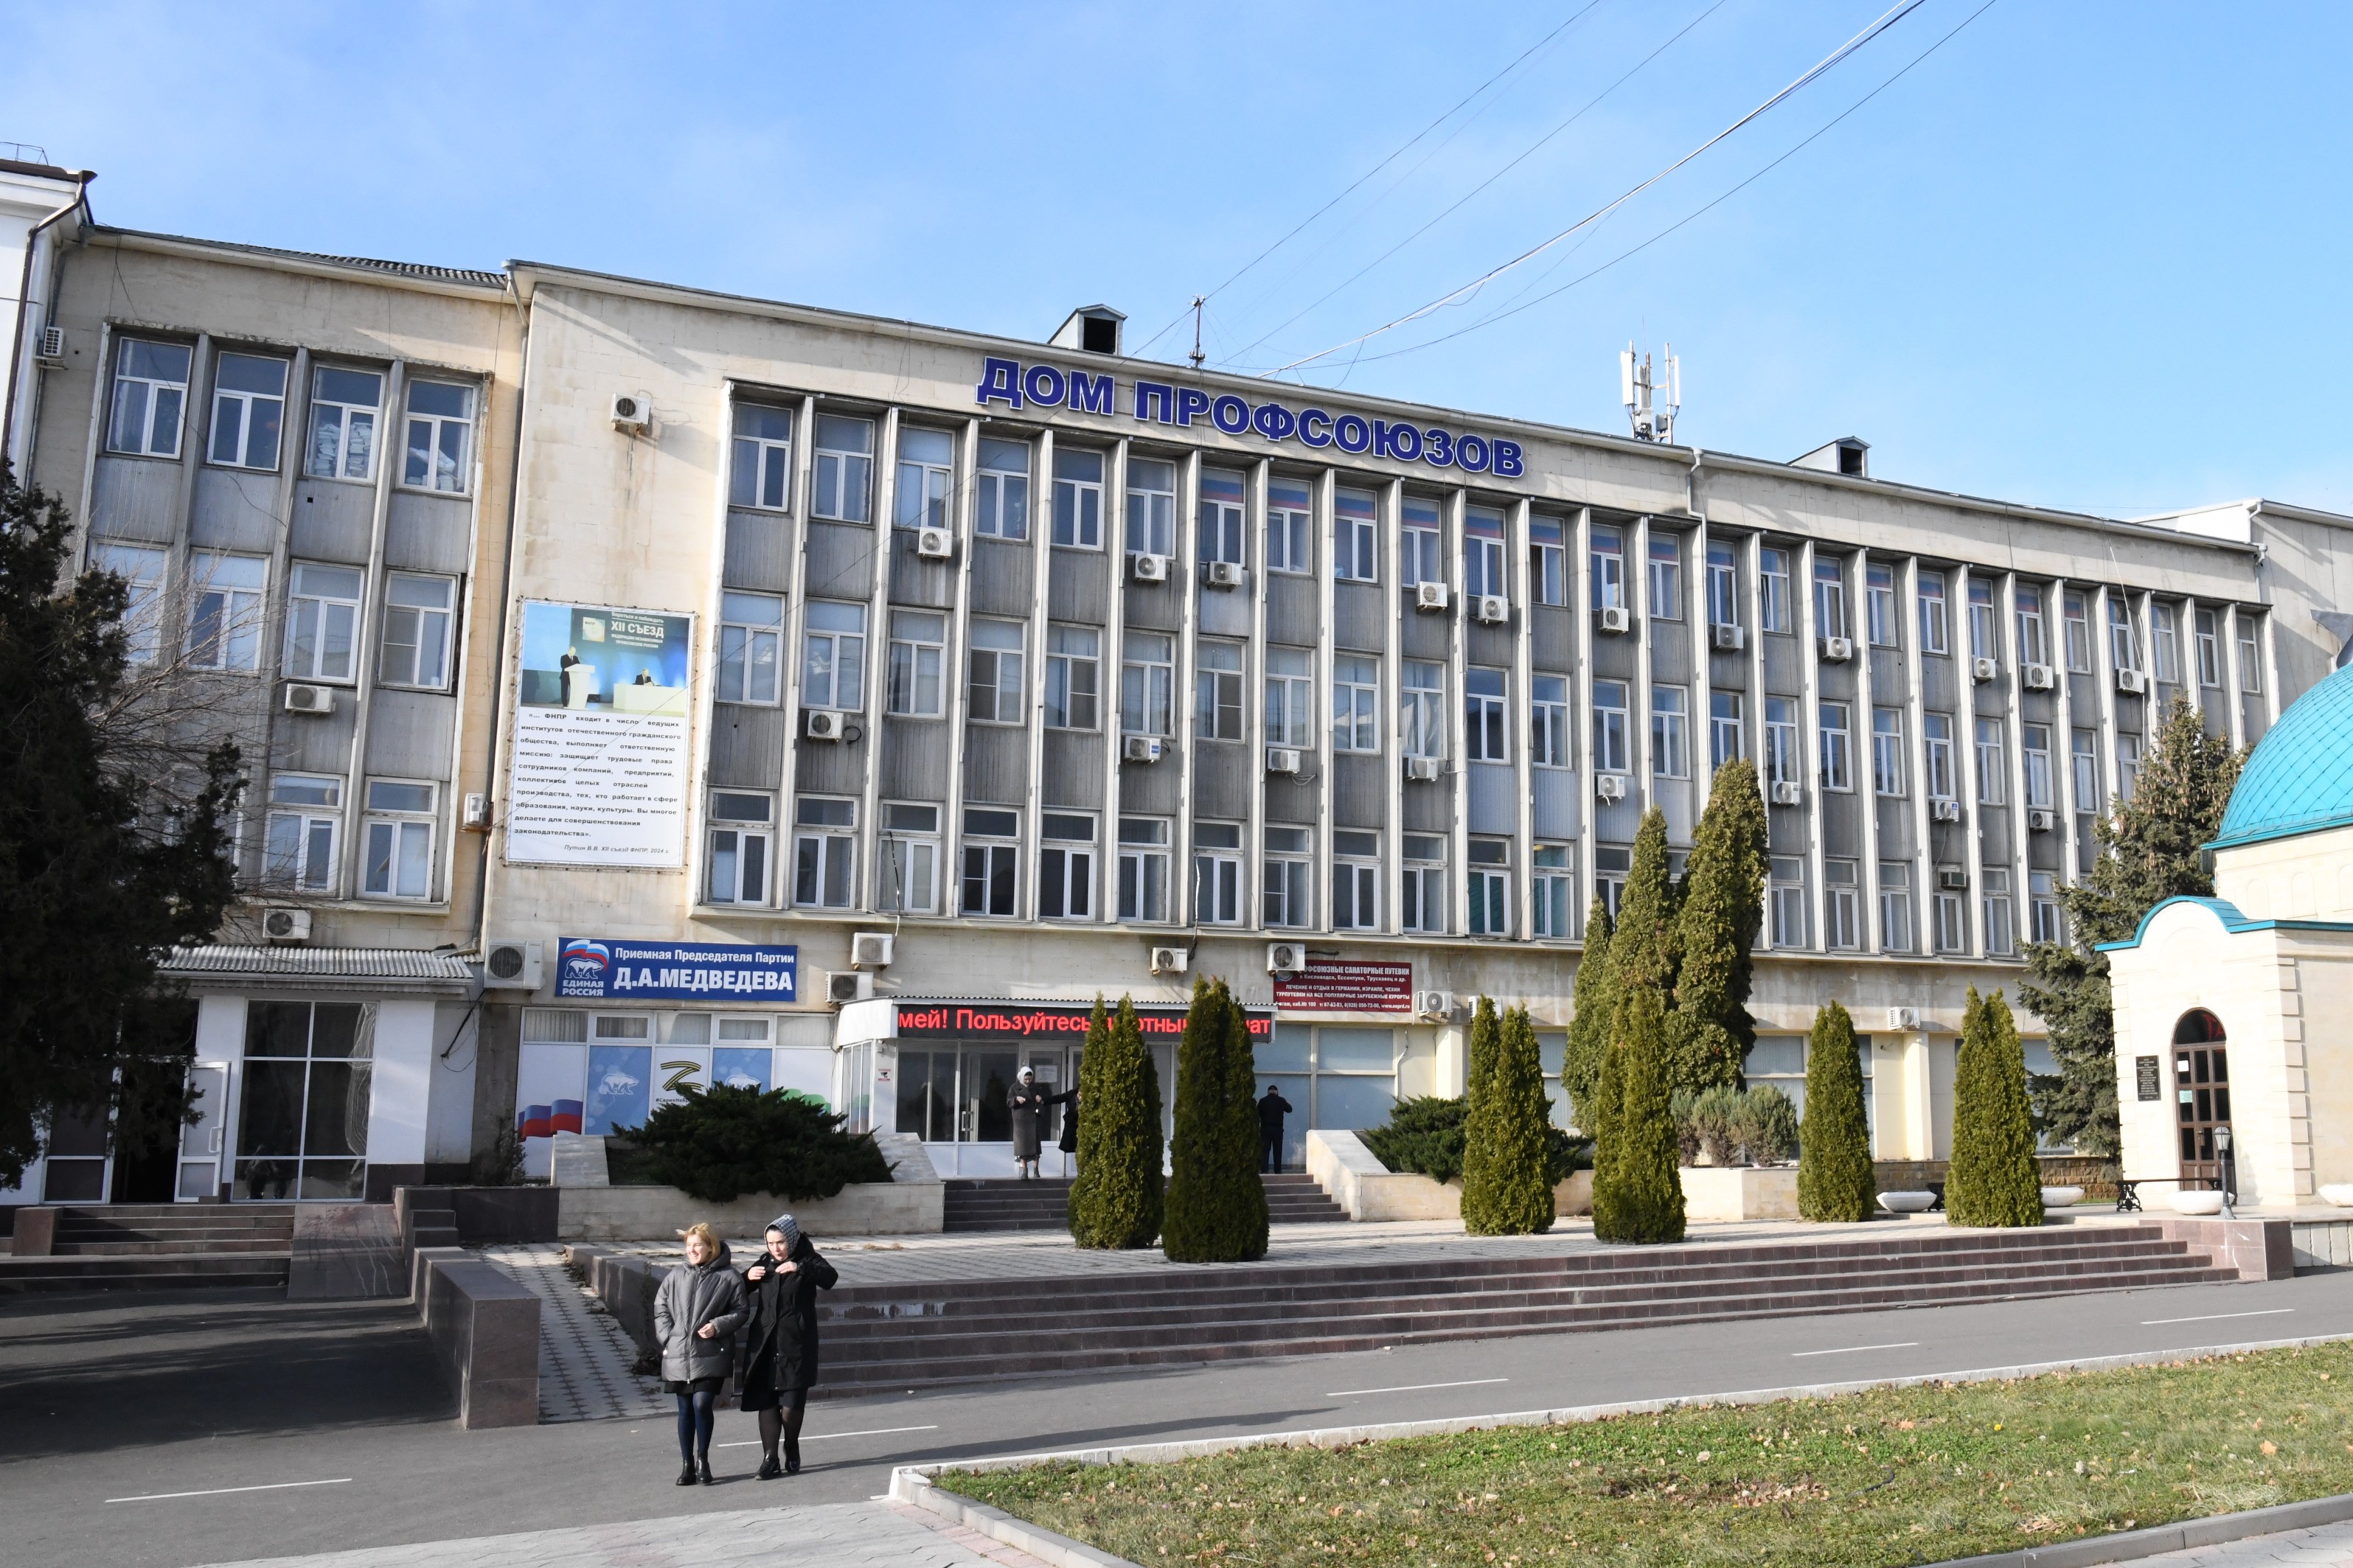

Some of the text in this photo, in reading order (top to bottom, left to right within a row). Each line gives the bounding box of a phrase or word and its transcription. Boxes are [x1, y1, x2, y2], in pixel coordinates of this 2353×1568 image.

[975, 355, 1525, 478] ДОМ ПРОФСОЮЗОВ
[628, 623, 664, 638] СЪЕЗД
[521, 725, 563, 733] институтов
[568, 728, 627, 736] отечественного
[520, 737, 560, 746] общества,
[620, 744, 675, 753] ответственную
[518, 763, 674, 778] сотрудников компаний, предприятий,
[516, 789, 572, 798] производства,
[515, 802, 569, 810] образования,
[564, 818, 641, 826] совершенствования
[616, 947, 794, 964] Приемная Председателя Партии
[1304, 965, 1410, 975] ОФСОЮЗНЫЕ САНАТОРНЫЕ ПУТЕВКИ
[563, 980, 604, 989] ЕДИНАЯ
[614, 967, 793, 993] Д.А.МЕДВЕДЕВА
[562, 988, 603, 996] РОССИЯ
[956, 1009, 1091, 1035] Пользуйтесь
